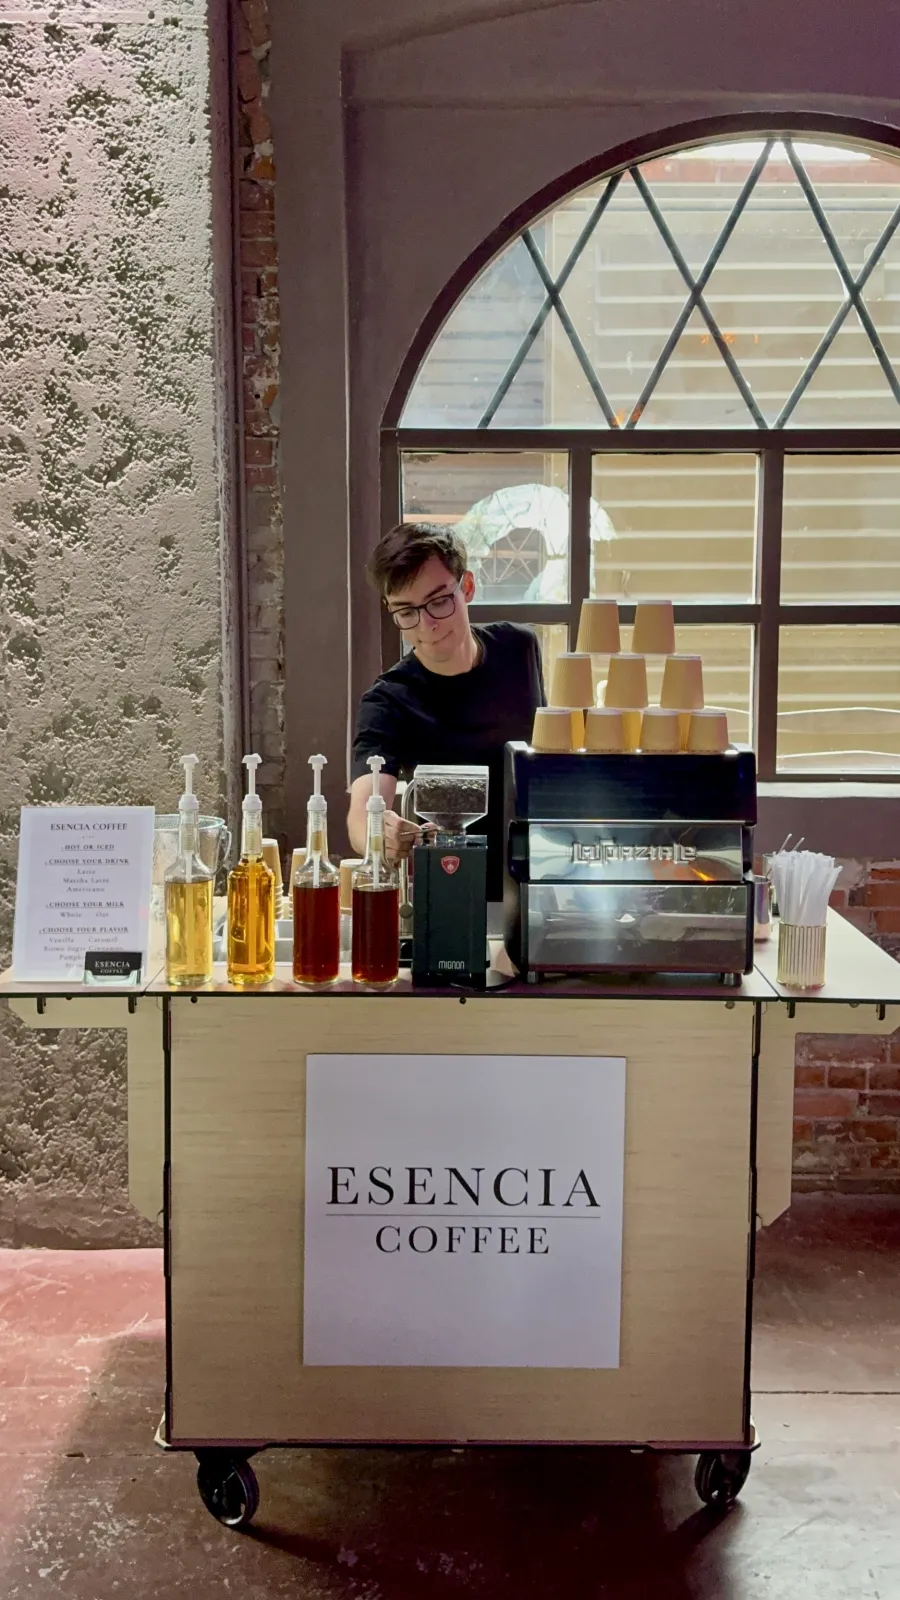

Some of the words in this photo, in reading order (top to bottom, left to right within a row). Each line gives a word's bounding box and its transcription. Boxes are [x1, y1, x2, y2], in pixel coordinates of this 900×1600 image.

[50, 823, 91, 831] ESENCIA
[92, 822, 128, 831] COFFEE
[94, 960, 131, 968] ESENCIA
[326, 1166, 601, 1208] ESENCIA
[375, 1225, 550, 1254] COFFEE
